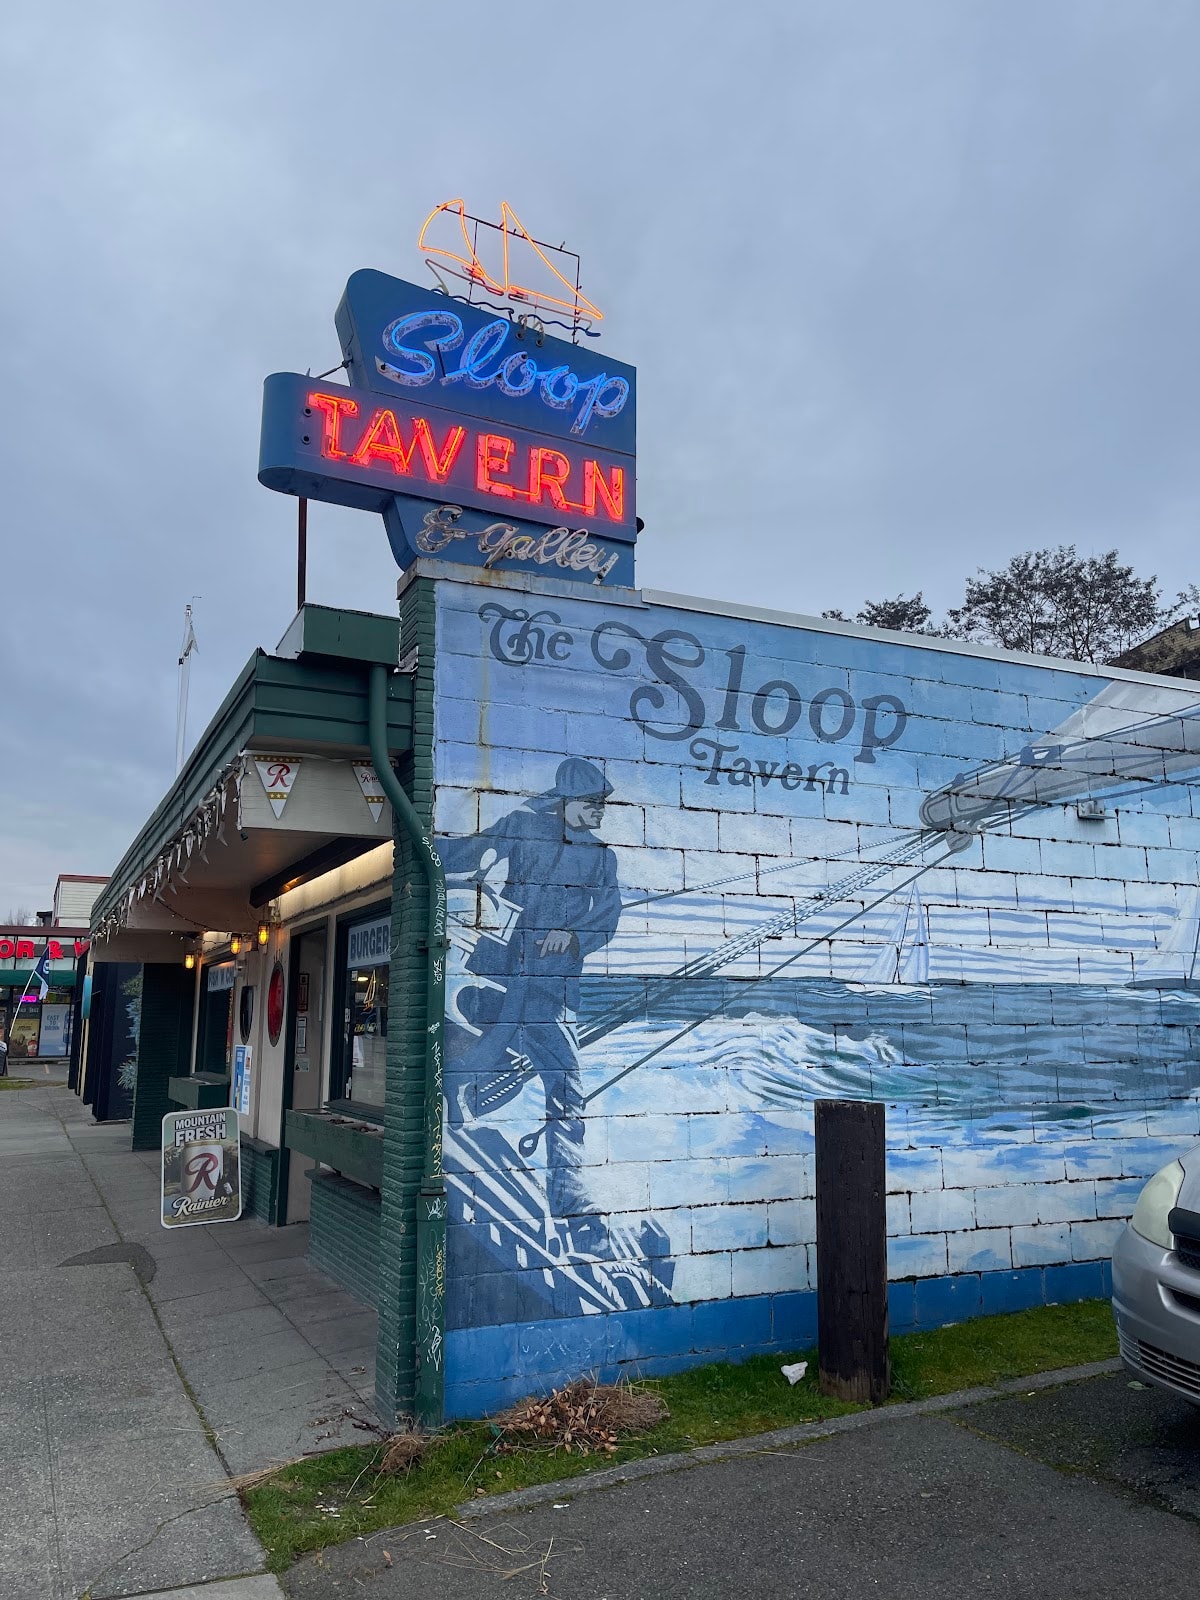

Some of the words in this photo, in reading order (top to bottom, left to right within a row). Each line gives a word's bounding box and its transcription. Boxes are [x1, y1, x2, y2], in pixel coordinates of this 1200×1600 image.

[375, 310, 630, 435] Sloop
[307, 392, 624, 522] TAVERN
[477, 522, 619, 584] galley
[478, 602, 574, 666] The
[591, 620, 907, 764] Sloop
[689, 737, 850, 796] Tavern
[175, 1113, 226, 1130] MOUNTAIN
[175, 1123, 226, 1147] FRESH
[172, 1196, 229, 1218] Rainier
